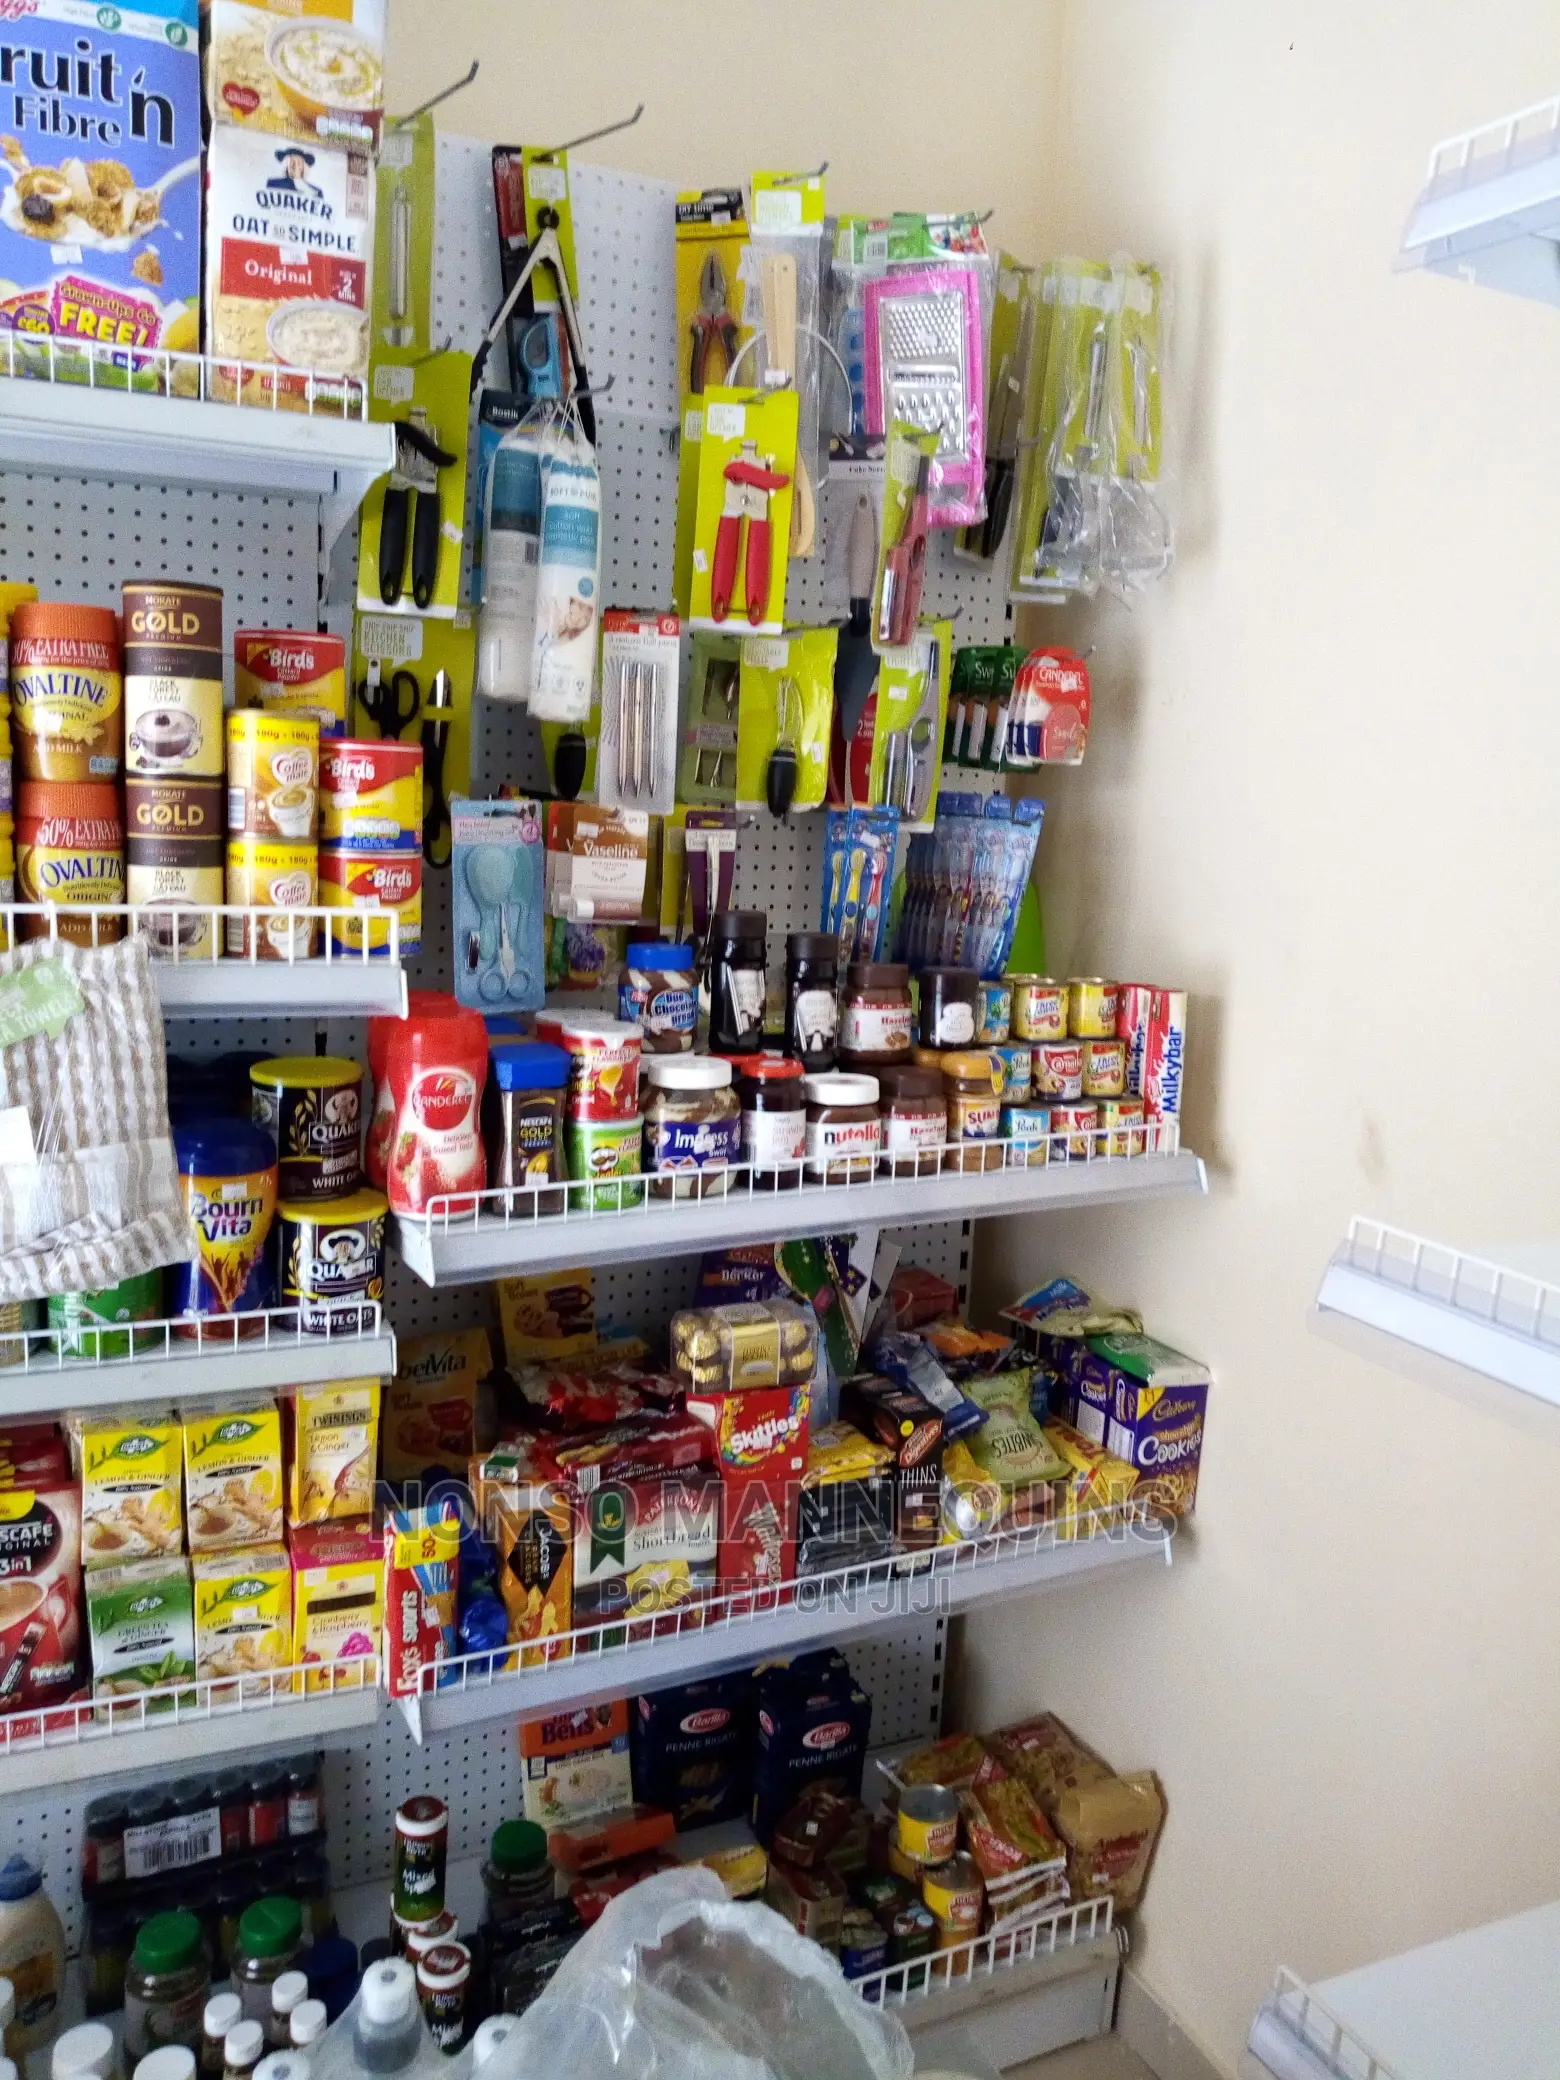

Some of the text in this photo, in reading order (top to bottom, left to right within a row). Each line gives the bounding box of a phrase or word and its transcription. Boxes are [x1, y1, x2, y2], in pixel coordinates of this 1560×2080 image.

[0, 38, 122, 106] ruit
[14, 93, 121, 147] Fibre
[256, 190, 333, 220] QUAKER
[232, 214, 268, 235] OAT
[288, 227, 356, 252] SIMPLE
[244, 259, 313, 287] Original
[60, 301, 148, 347] FREE!
[131, 610, 200, 635] GOLD
[276, 757, 310, 775] Coffee
[136, 802, 205, 827] GOLD
[39, 817, 74, 848] 50%
[583, 841, 640, 859] Vaseline
[1161, 1026, 1183, 1114] Milkybar
[520, 1125, 552, 1139] GOLD
[674, 1128, 729, 1149] Imess
[824, 1122, 881, 1145] nutella
[191, 1193, 264, 1218] Bourn
[198, 1217, 252, 1241] Vita
[307, 1259, 375, 1280] QUAR
[311, 1412, 367, 1427] TWININGS
[1152, 1397, 1198, 1423] Cadbury
[730, 1415, 799, 1455] Skittles
[900, 1464, 938, 1490] THINS
[0, 1523, 53, 1544] SCAFE
[0, 1537, 51, 1552] GINAL
[665, 1741, 701, 1753] PENNE
[789, 1756, 824, 1769] PENNE
